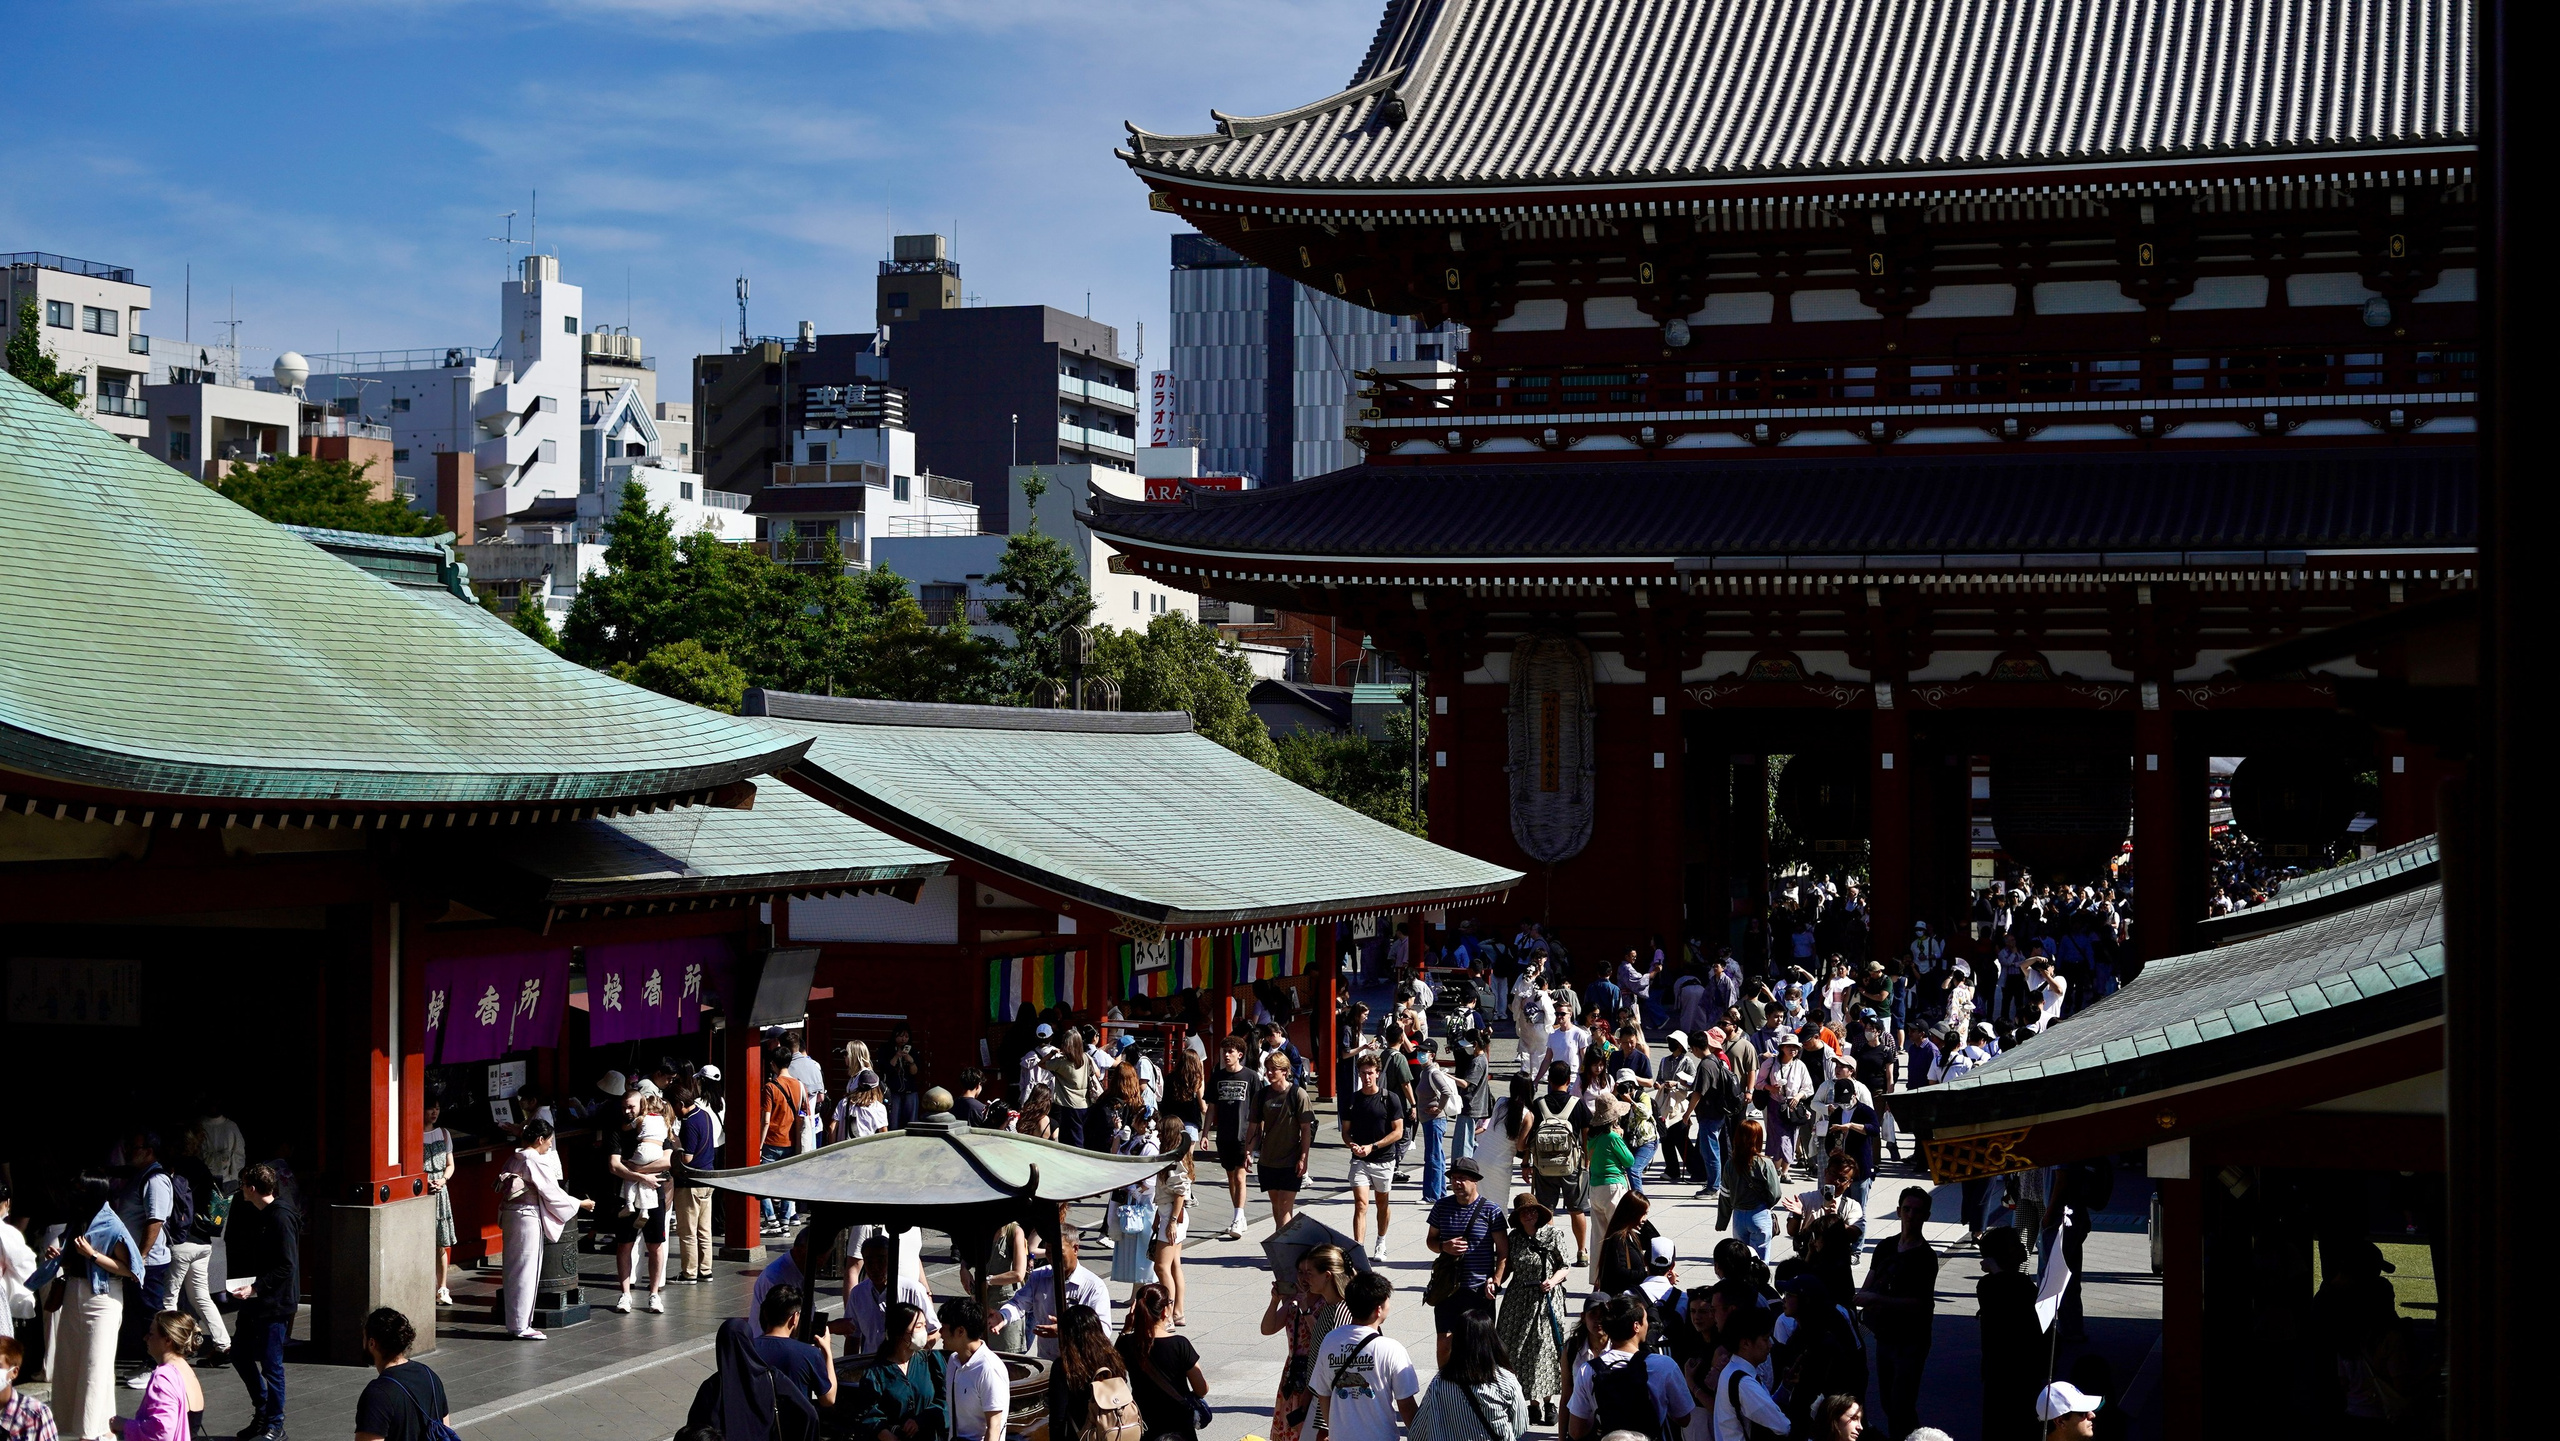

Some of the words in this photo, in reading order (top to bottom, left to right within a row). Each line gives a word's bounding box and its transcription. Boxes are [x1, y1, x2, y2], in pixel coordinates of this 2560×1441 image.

[1154, 373, 1165, 441] カラオケ
[603, 963, 702, 1012] 授香所
